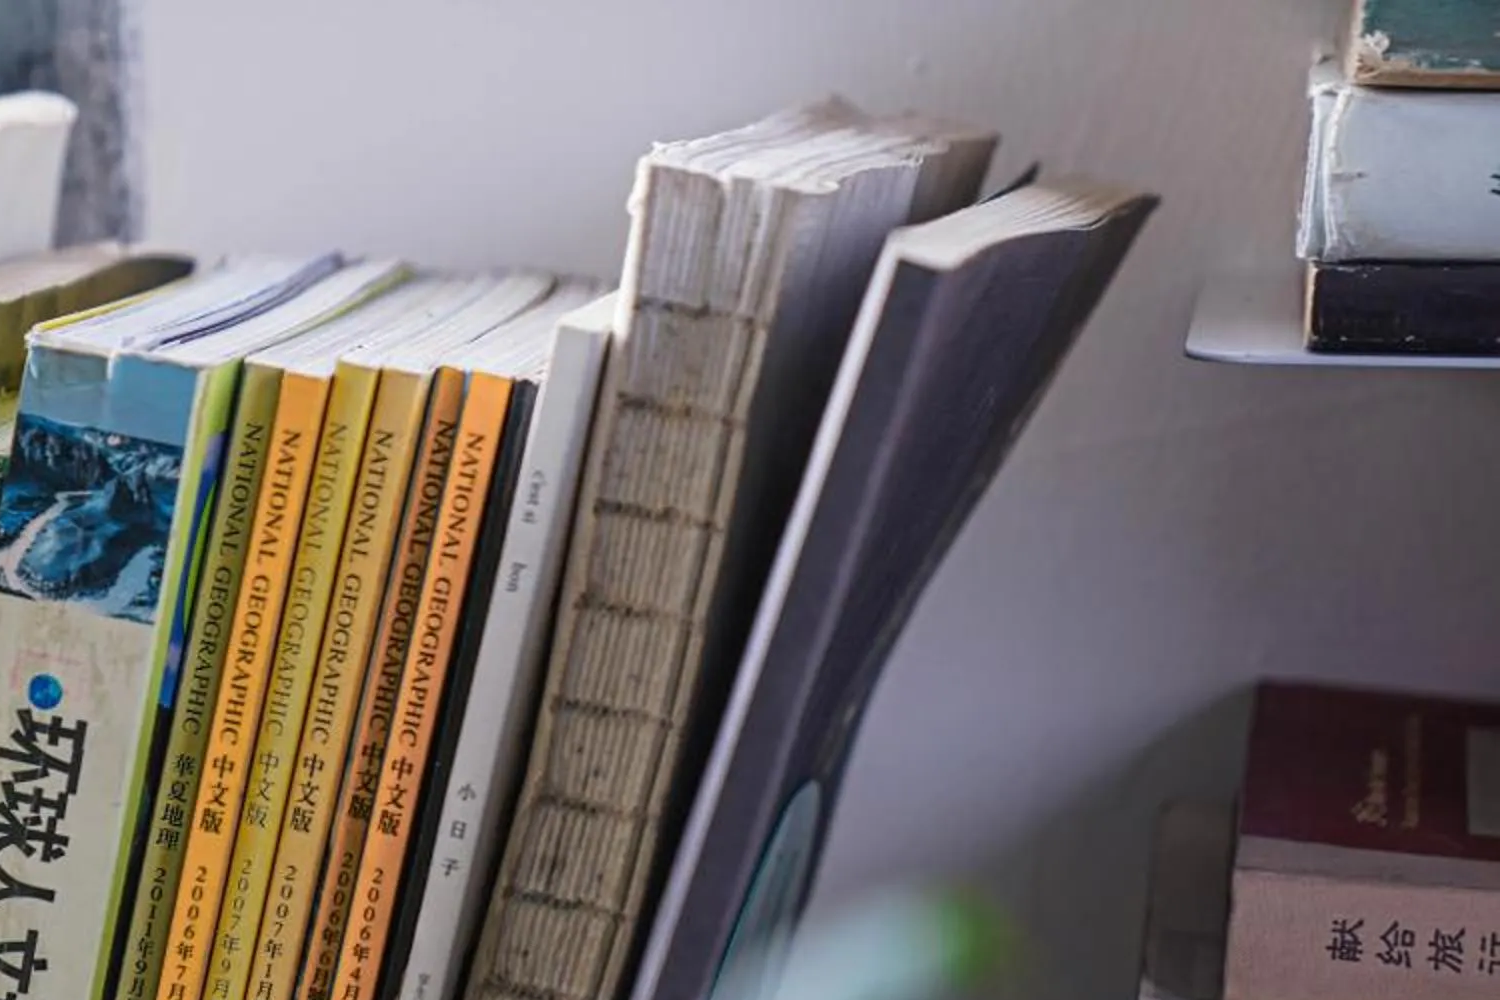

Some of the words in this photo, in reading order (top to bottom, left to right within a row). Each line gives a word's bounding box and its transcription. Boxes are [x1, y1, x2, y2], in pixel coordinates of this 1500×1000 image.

[217, 422, 264, 553] NATIONAL
[257, 429, 302, 562] NATIONAL
[302, 421, 347, 549] NATIONAL
[350, 430, 394, 560] NATIONAL
[411, 419, 455, 551] NATIONAL
[440, 431, 485, 563] NATIONAL
[182, 566, 233, 736] GEOGRAPHIC
[219, 574, 270, 746] GEOGRAPHIC
[264, 566, 317, 738] GEOGRAPHIC
[309, 573, 361, 745] GEOGRAPHIC
[369, 562, 422, 737] GEOGRAPHIC
[401, 576, 452, 747] GEOGRAPHIC
[200, 754, 235, 835] 中文版
[246, 752, 280, 829] 中文版
[290, 754, 325, 834] 中文版
[348, 742, 384, 823] 中文版
[377, 756, 413, 837] 中文版
[441, 783, 477, 877] 小日子
